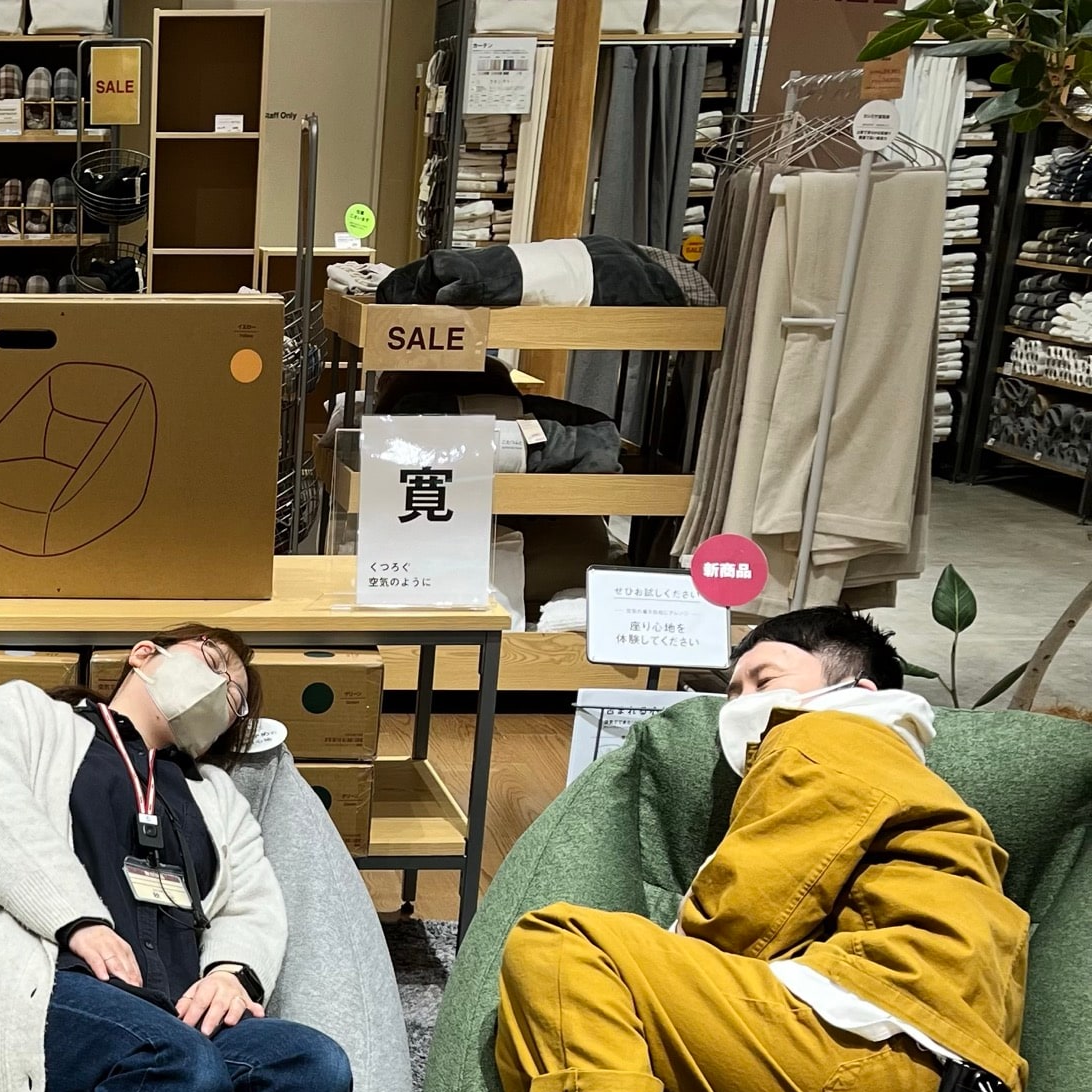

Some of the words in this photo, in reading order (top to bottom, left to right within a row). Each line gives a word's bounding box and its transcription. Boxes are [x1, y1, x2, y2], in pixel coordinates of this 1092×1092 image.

[96, 80, 134, 94] SALE
[280, 111, 297, 120] Only
[387, 326, 465, 351] SALE
[398, 466, 454, 524] 寛
[370, 562, 410, 572] くつろぐ
[702, 562, 752, 579] 新商品
[369, 577, 432, 588] 空気のように
[630, 621, 685, 634] 座り心地を
[616, 633, 700, 647] 体験してください
